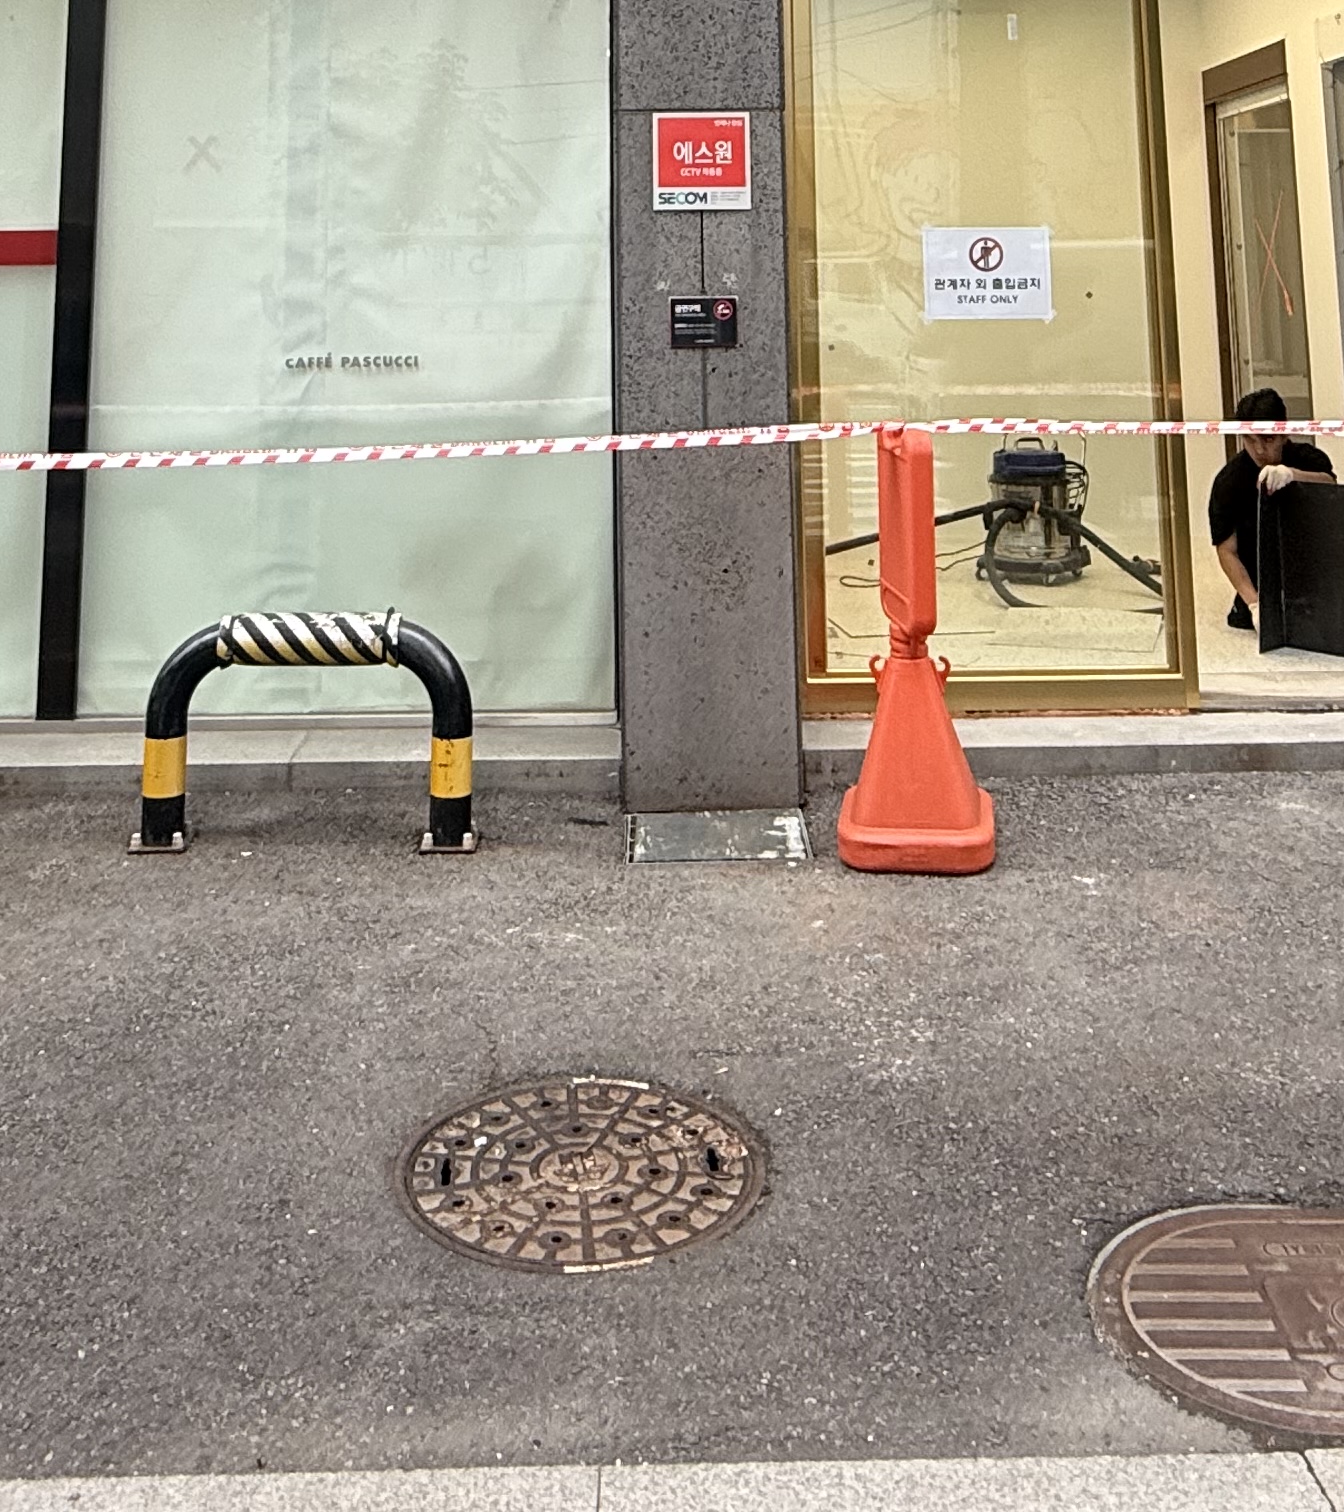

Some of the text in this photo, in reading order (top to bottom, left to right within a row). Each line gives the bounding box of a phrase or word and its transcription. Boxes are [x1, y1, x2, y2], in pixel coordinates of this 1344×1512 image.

[673, 140, 733, 165] 에스원
[680, 167, 701, 177] CCTV
[658, 192, 708, 205] SECOM
[956, 294, 1019, 304] STAFF ONLY
[285, 352, 419, 370] CAFFÉ PASCUCCI
